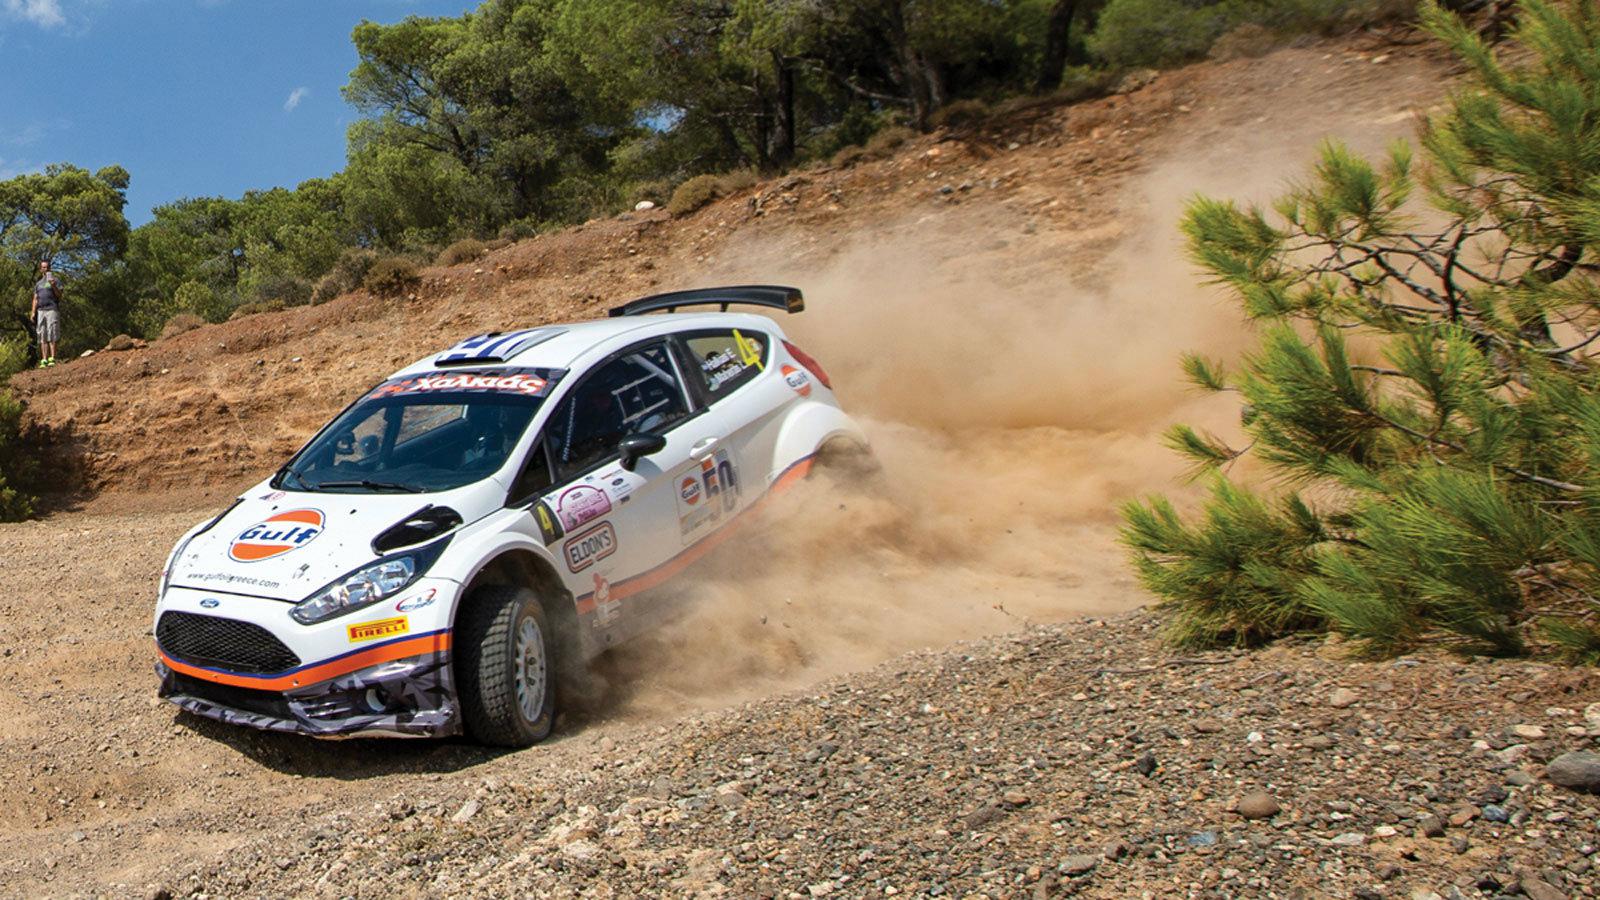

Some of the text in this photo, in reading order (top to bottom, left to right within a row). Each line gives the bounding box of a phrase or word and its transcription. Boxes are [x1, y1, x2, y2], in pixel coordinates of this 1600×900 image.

[732, 328, 765, 373] 4
[786, 369, 810, 388] Gulf
[681, 482, 701, 500] Gulf
[537, 505, 555, 535] 4
[239, 524, 318, 544] Gulf
[569, 529, 612, 564] ELDON'S
[349, 618, 407, 639] PIRELLI
